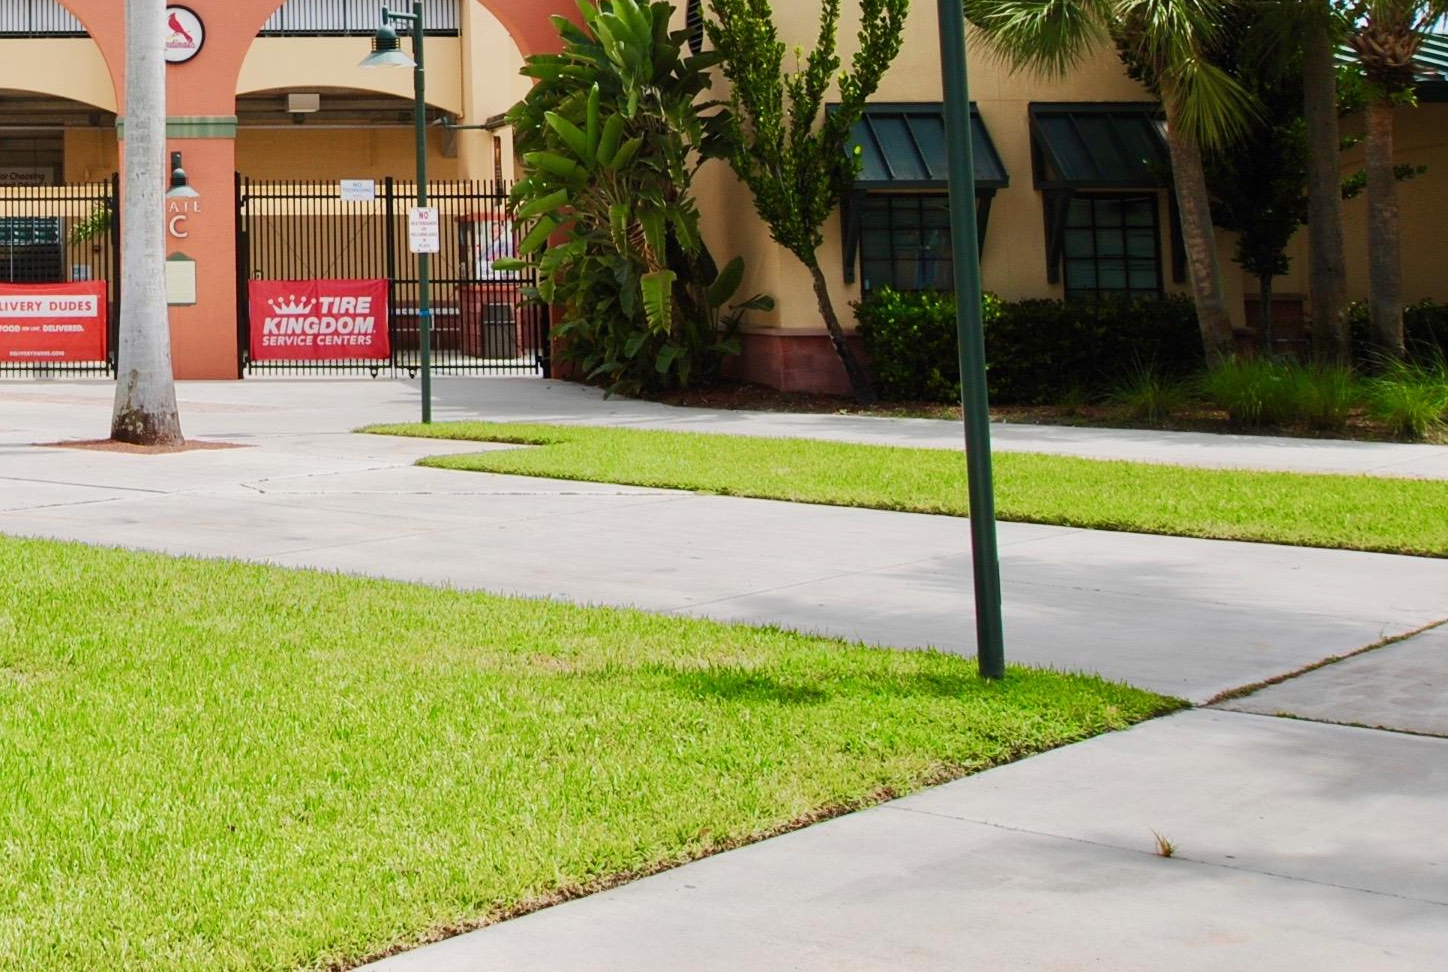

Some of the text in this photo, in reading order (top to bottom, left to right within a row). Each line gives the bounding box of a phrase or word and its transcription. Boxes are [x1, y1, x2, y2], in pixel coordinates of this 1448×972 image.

[168, 200, 202, 213] ATE
[418, 211, 429, 220] NO
[169, 214, 188, 238] C
[49, 301, 92, 311] DUDES
[319, 296, 372, 315] TIRE
[263, 316, 375, 335] KINGDOM
[262, 335, 372, 346] SERVICE CENTERS
